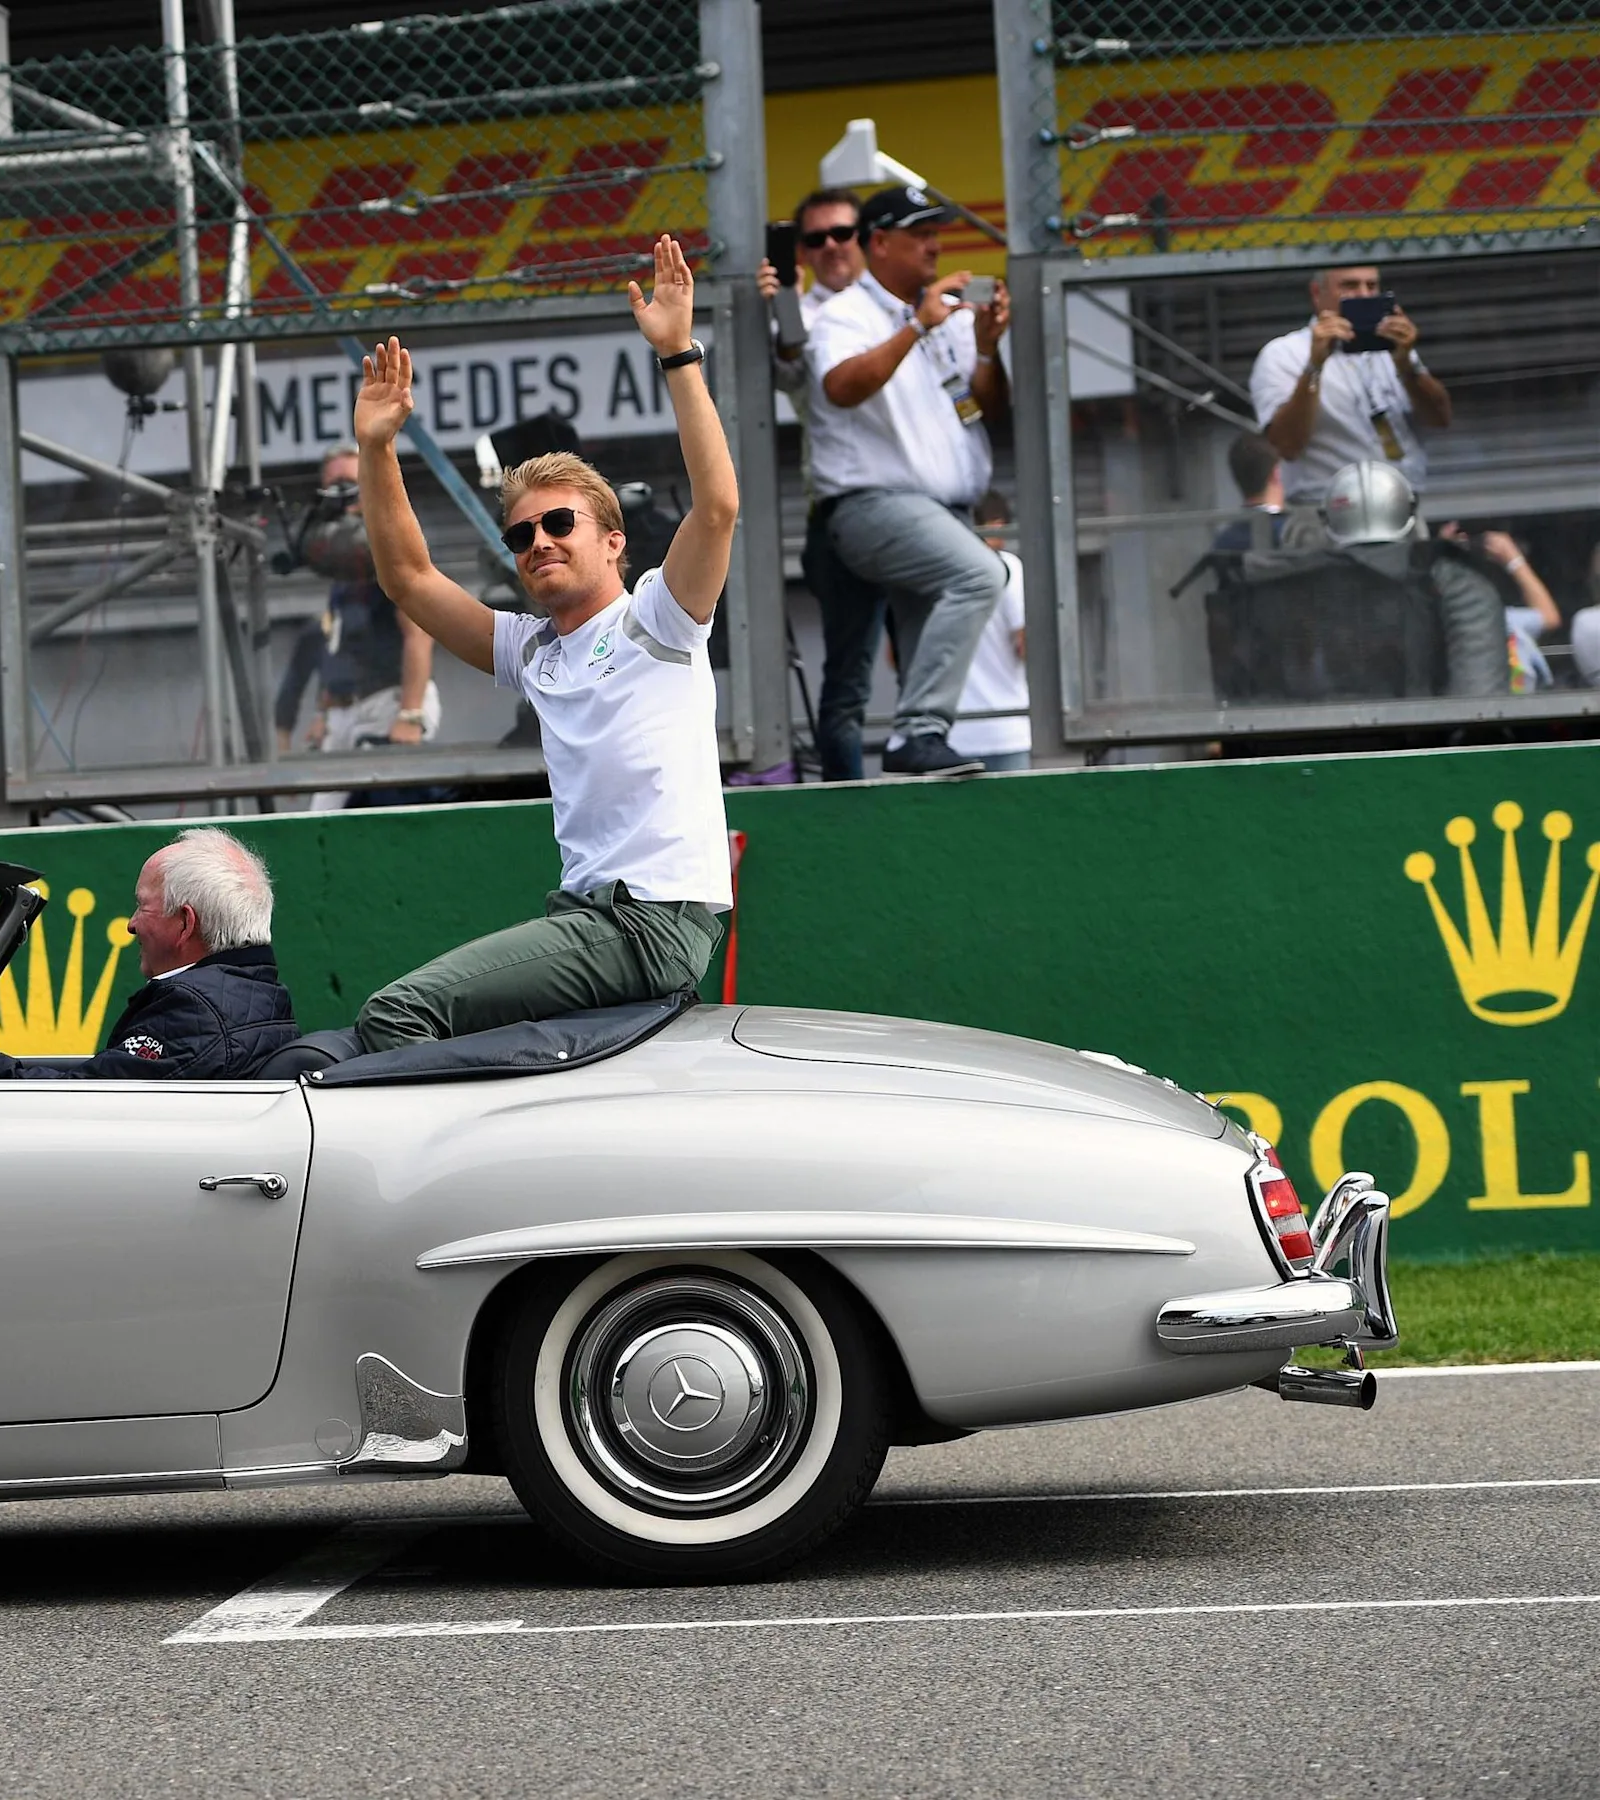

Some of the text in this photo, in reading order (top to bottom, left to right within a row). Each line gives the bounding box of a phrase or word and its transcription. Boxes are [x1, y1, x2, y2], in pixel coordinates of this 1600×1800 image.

[1068, 57, 1600, 238] DH
[256, 354, 582, 446] MEEDES
[143, 1036, 164, 1056] SPA
